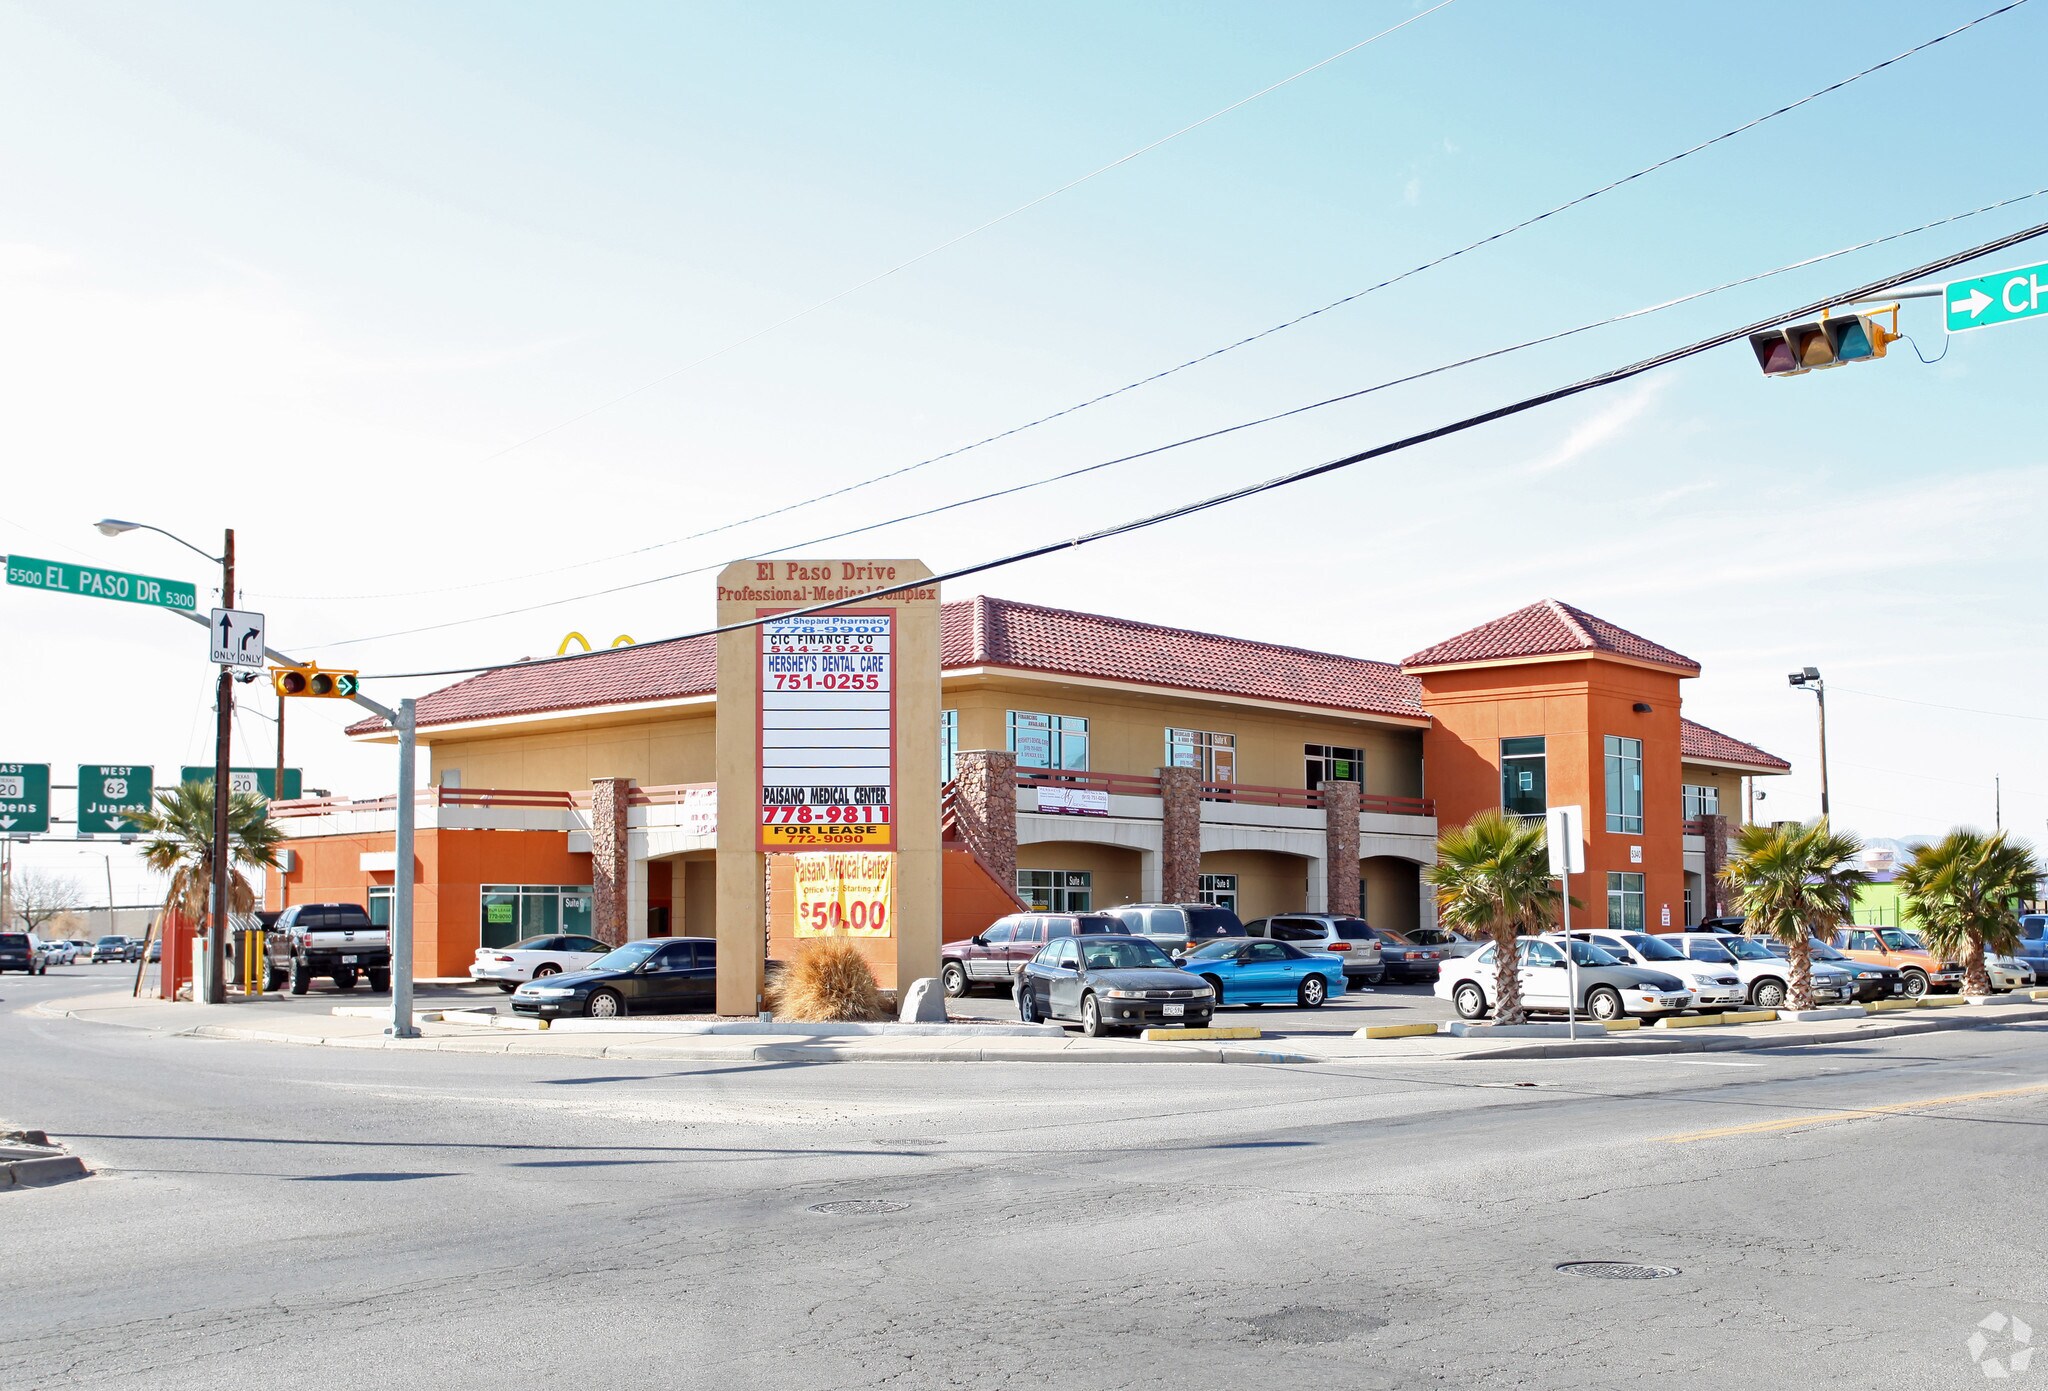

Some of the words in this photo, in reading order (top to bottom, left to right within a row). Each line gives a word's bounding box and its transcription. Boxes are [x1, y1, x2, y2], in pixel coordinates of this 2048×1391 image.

[756, 562, 775, 580] El
[786, 562, 831, 580] Paso
[842, 562, 896, 580] Drive
[10, 568, 42, 585] 5500
[46, 566, 70, 590] EL
[79, 571, 129, 598] PASO
[136, 580, 161, 602] DR
[166, 592, 194, 607] 5300
[764, 617, 790, 625] ood
[794, 617, 830, 626] Shepard
[832, 617, 890, 626] Pharmacy
[770, 635, 790, 645] CIC
[798, 635, 850, 644] FINANCE
[858, 635, 874, 644] CO
[771, 645, 874, 653] 544-2926
[214, 650, 236, 660] ONLY
[240, 654, 262, 664] ONLY
[768, 656, 817, 672] HERSHEY'S
[822, 656, 856, 672] DENTAL
[860, 656, 884, 672] CARE
[774, 674, 879, 690] 751-0255
[0, 764, 24, 774] AST
[100, 766, 132, 776] WEST
[0, 784, 17, 796] 20
[106, 782, 126, 794] 62
[233, 780, 252, 792] 20
[764, 787, 806, 804] PAISANO
[810, 787, 850, 804] MEDICAL
[854, 786, 887, 804] CENTER
[764, 806, 889, 824] 778-9811
[774, 826, 811, 834] FOR
[818, 826, 877, 834] LEASE
[787, 834, 864, 844] 772-9090
[796, 856, 826, 882] Paisano
[828, 854, 860, 880] Medical
[1068, 875, 1080, 886] Suite
[1080, 876, 1084, 886] A
[804, 886, 824, 894] Office
[842, 884, 871, 893] Starting
[565, 898, 580, 908] Suite
[800, 900, 886, 930] $50.00
